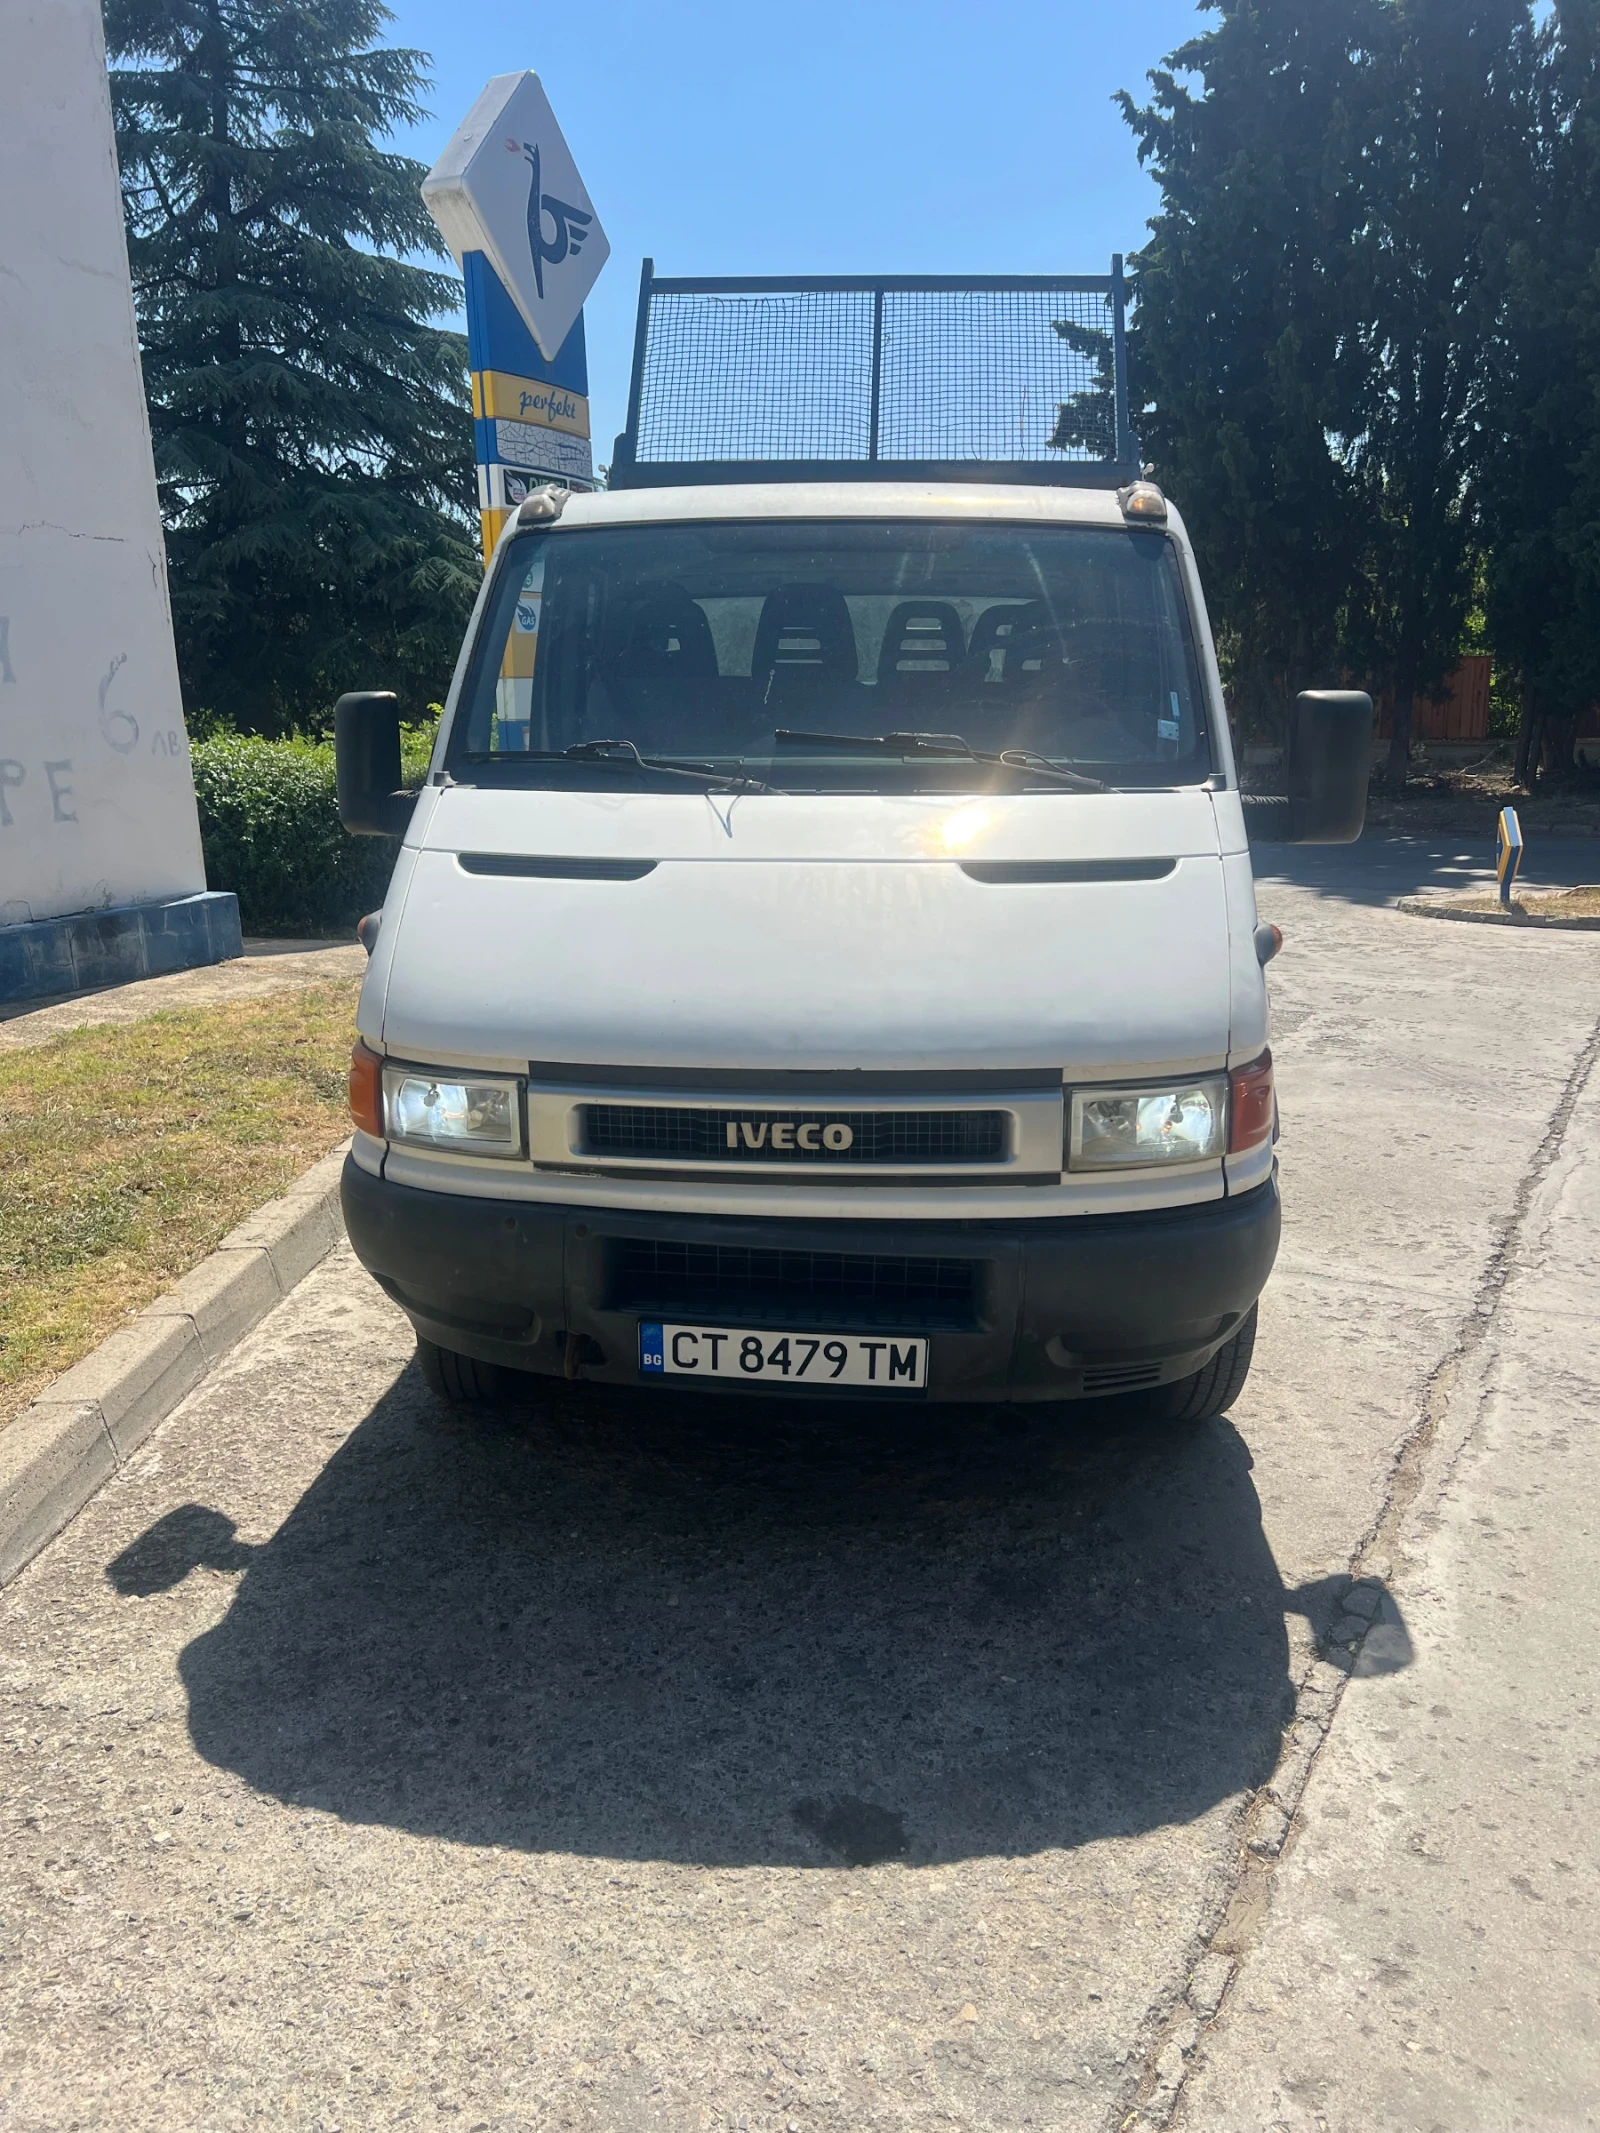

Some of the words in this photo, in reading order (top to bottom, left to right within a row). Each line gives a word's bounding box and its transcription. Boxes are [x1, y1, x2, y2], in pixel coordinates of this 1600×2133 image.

[519, 391, 576, 423] perfekt
[521, 615, 535, 626] GAS
[98, 652, 140, 755] 6
[726, 1121, 853, 1151] IVECO
[643, 1353, 662, 1366] BG
[671, 1331, 728, 1371] CT
[739, 1336, 848, 1378] 8479
[859, 1342, 918, 1382] TM
